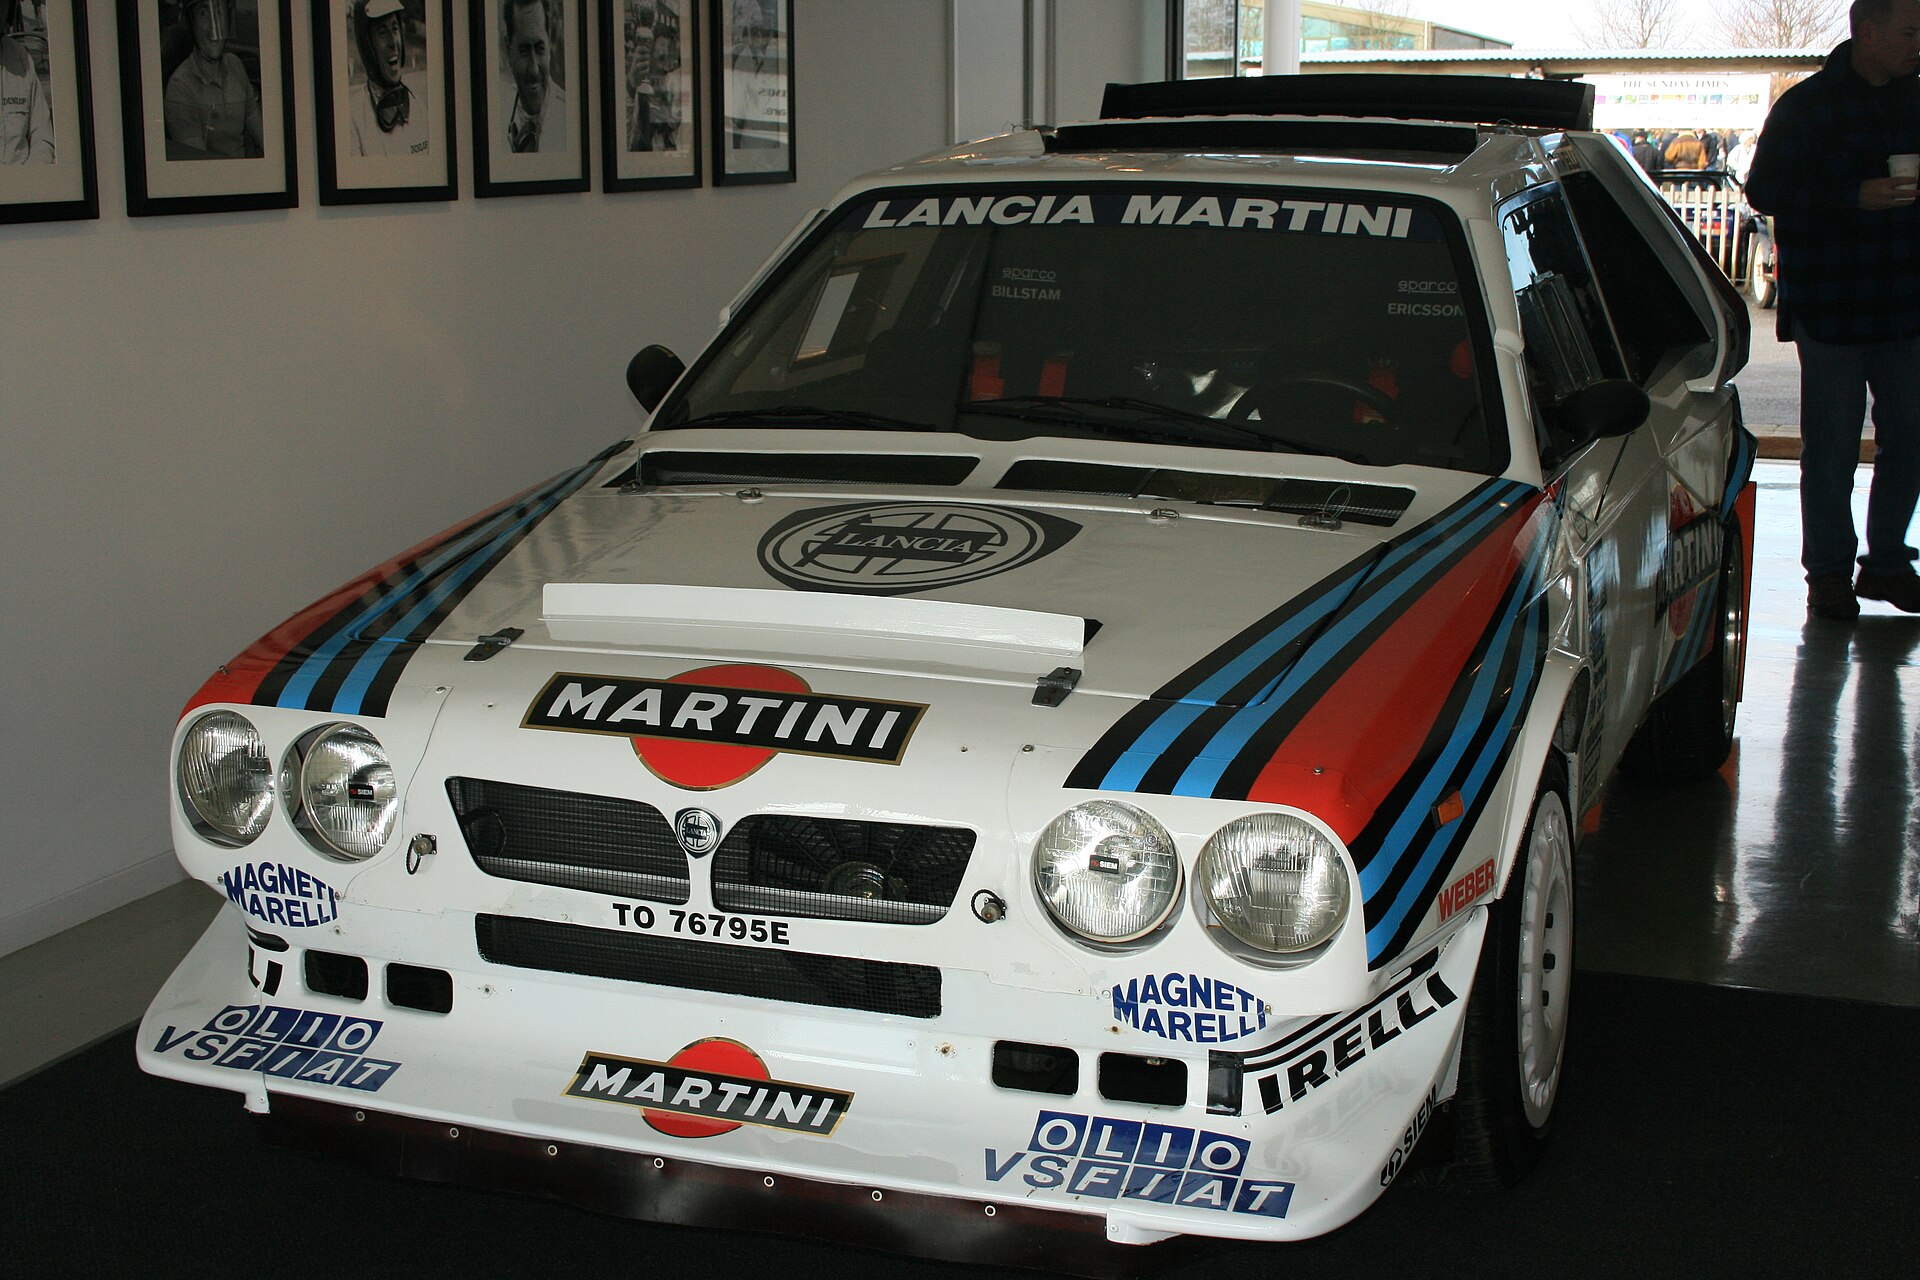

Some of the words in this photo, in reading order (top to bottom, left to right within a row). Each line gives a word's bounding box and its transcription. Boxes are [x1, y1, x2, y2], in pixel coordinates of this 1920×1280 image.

[863, 195, 1094, 228] LANCIA
[1121, 195, 1413, 238] MARTINI
[992, 285, 1061, 300] BILLSTAM
[835, 532, 973, 554] LANCIA
[546, 682, 902, 750] MARTINI
[223, 861, 337, 902] MAGNETI
[1099, 860, 1118, 871] SIEM
[224, 887, 338, 928] MARELLI
[1438, 858, 1495, 922] WEBER
[612, 903, 656, 930] TO
[669, 909, 790, 946] 76795E
[1112, 972, 1266, 1015] MAGNETI
[213, 1008, 374, 1051] OLIO
[1112, 1003, 1267, 1043] MARELLI
[579, 1062, 836, 1128] MARTINI
[1403, 1083, 1437, 1155] SIEM
[1036, 1117, 1242, 1172] OLIO
